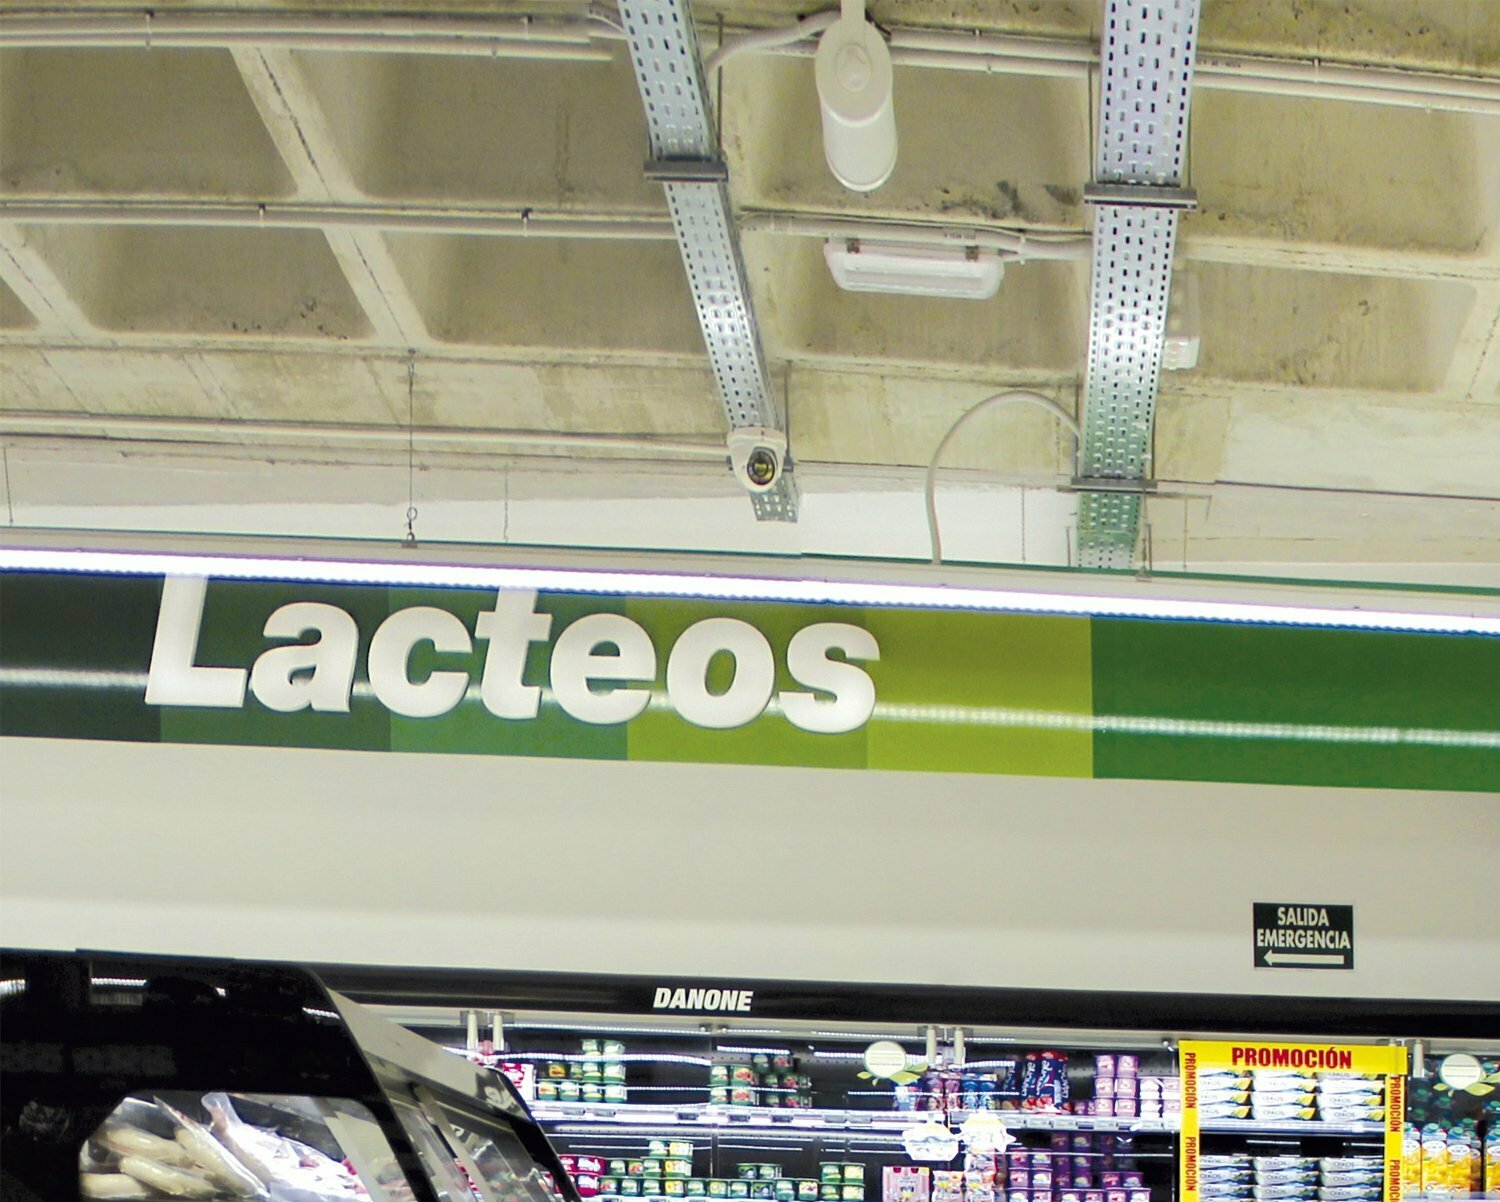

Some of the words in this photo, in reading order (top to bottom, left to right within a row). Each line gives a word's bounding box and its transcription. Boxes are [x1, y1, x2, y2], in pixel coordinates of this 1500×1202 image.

[145, 571, 881, 735] Lacteos
[1277, 907, 1330, 926] SALIDA
[1257, 929, 1351, 949] EMERGENCIA
[653, 987, 754, 1012] DANONE
[1232, 1046, 1352, 1069] PROMOCIÓN
[1184, 1052, 1197, 1109] PROMOCIÓN
[1390, 1076, 1402, 1133] PROMOCIÓN
[1184, 1136, 1197, 1192] PROMOCIÓN
